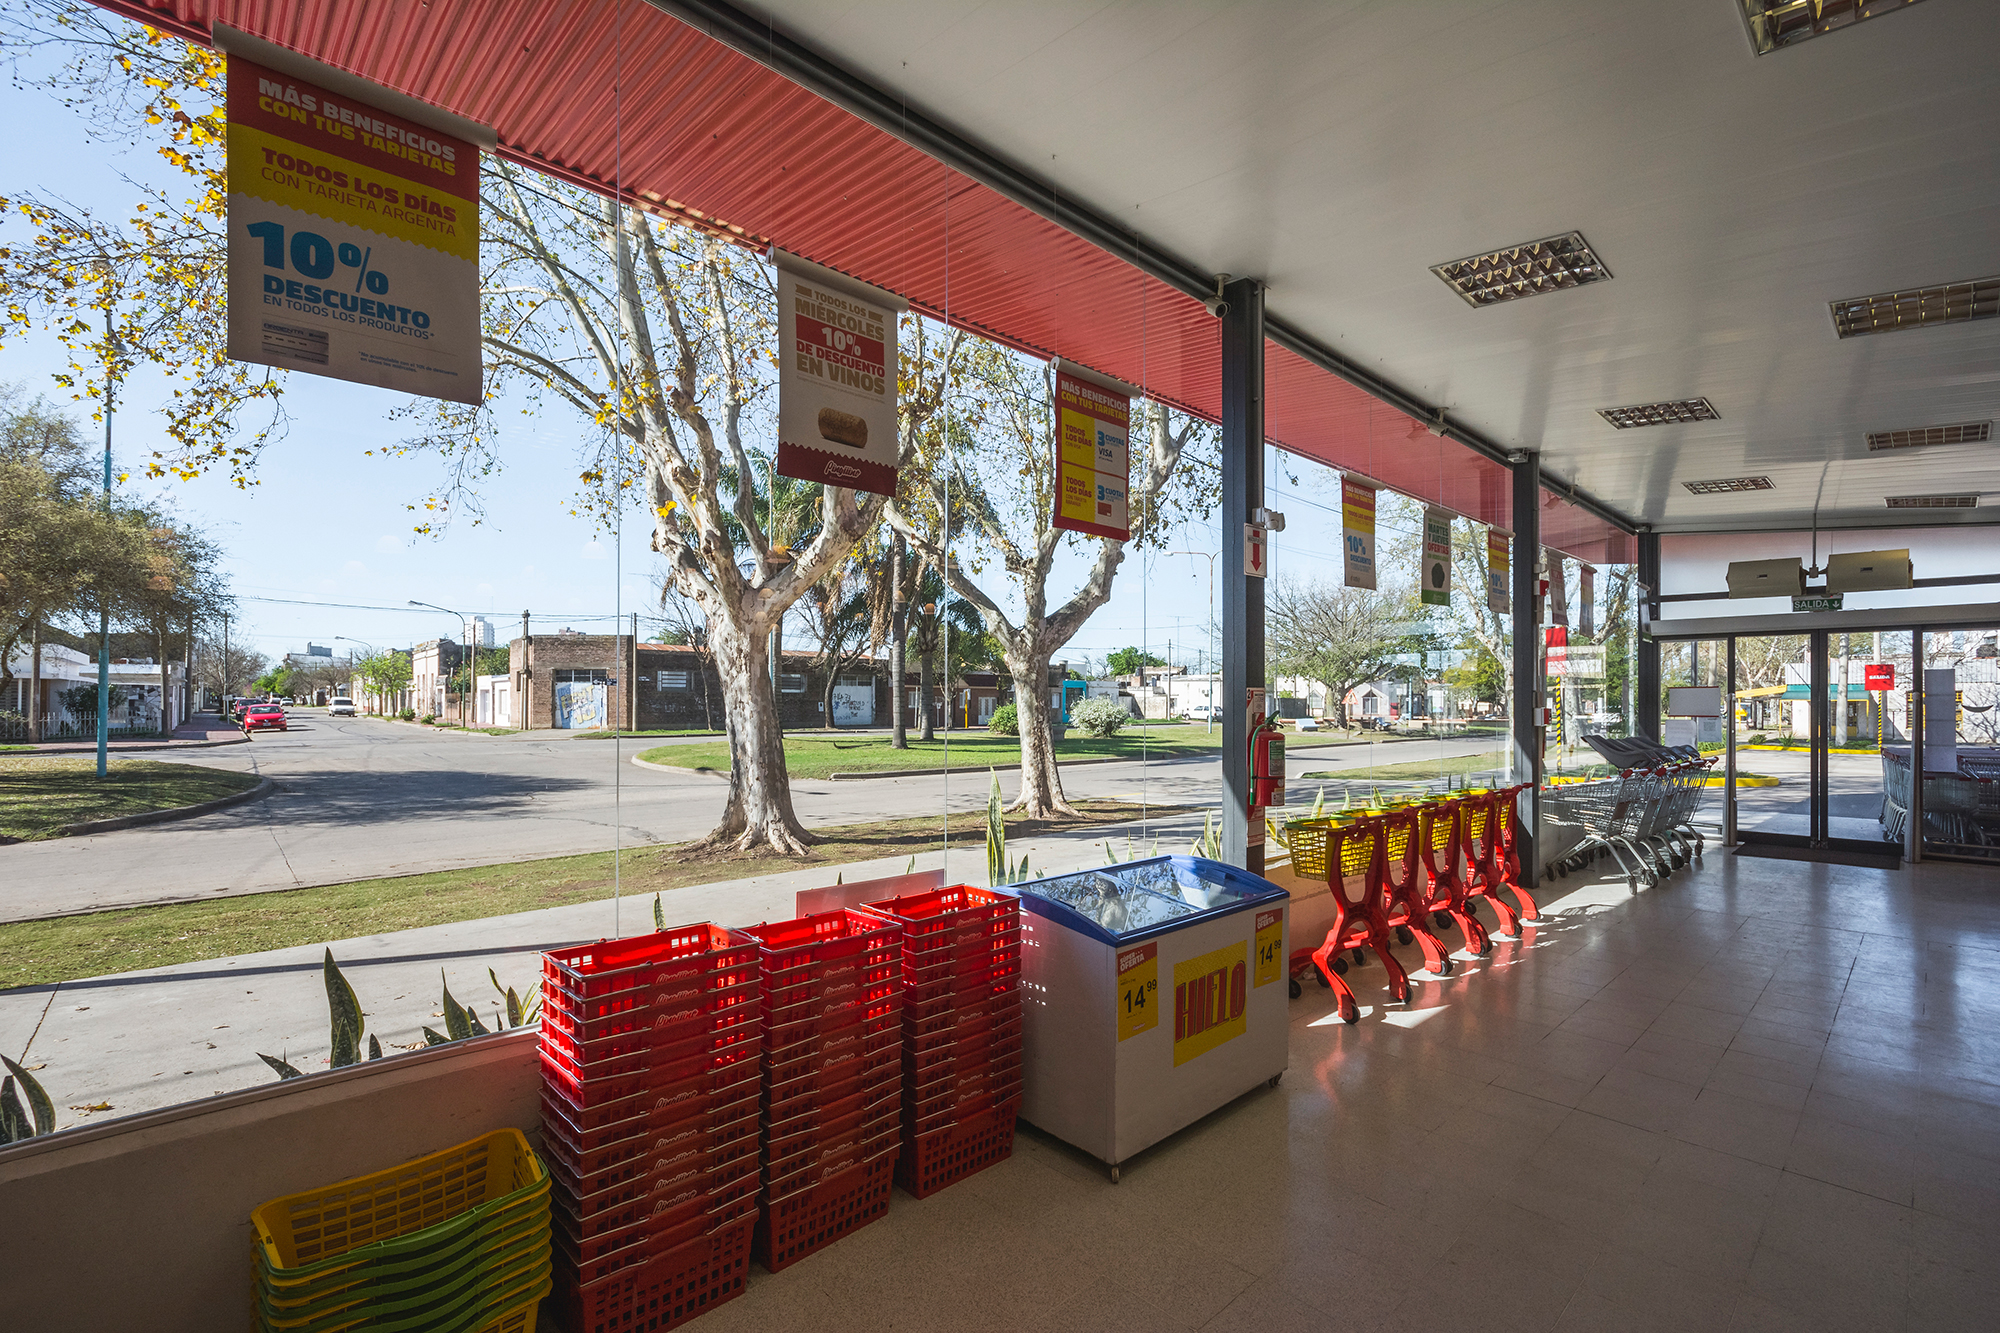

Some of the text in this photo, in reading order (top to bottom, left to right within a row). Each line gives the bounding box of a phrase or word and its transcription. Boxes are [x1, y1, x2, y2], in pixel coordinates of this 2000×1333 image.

[259, 78, 456, 162] MÁS BENEFICIOS
[259, 97, 456, 177] CON TUS TARJETAS
[261, 146, 457, 223] TODOS LOS DÍAS
[261, 167, 456, 237] CON TARJETA ARGENTA
[247, 221, 389, 295] 10%
[263, 274, 431, 329] DESCUENTO
[263, 295, 282, 308] EN
[286, 298, 329, 318] TODOS
[332, 308, 356, 324] LOS
[814, 291, 867, 317] TODOS LOS
[795, 297, 885, 342] MIÉRCOLES
[821, 326, 862, 357] 10%
[796, 339, 885, 378] DE DESCUENTO
[796, 353, 823, 378] EN
[827, 362, 885, 396] VINOS
[1061, 380, 1128, 413] MÁS BENEFICIOS
[1061, 391, 1127, 422] CON TUS TARJETAS
[1065, 424, 1085, 437] TODOS
[1065, 432, 1092, 447] LOS DÍAS
[1097, 430, 1105, 447] 3
[1105, 434, 1125, 446] CUOTAS
[1097, 446, 1113, 458] VISA
[1065, 476, 1085, 489] TODOS
[1066, 484, 1092, 499] LOS DÍAS
[1097, 485, 1105, 501] 3
[1105, 487, 1125, 499] CUOTAS
[1428, 523, 1449, 537] MARTES
[1428, 533, 1449, 546] Y JUEVES
[1346, 535, 1366, 556] 10%
[1427, 542, 1449, 556] OFERTAS
[1794, 599, 1829, 609] SALIDA
[1257, 916, 1275, 930] OFERTA
[1119, 952, 1135, 965] SÚPER
[1120, 953, 1145, 972] OFERTA
[1260, 939, 1282, 966] 14 99
[1124, 985, 1146, 1014] 14
[1146, 979, 1158, 992] 99
[1175, 960, 1246, 1044] HIELO
